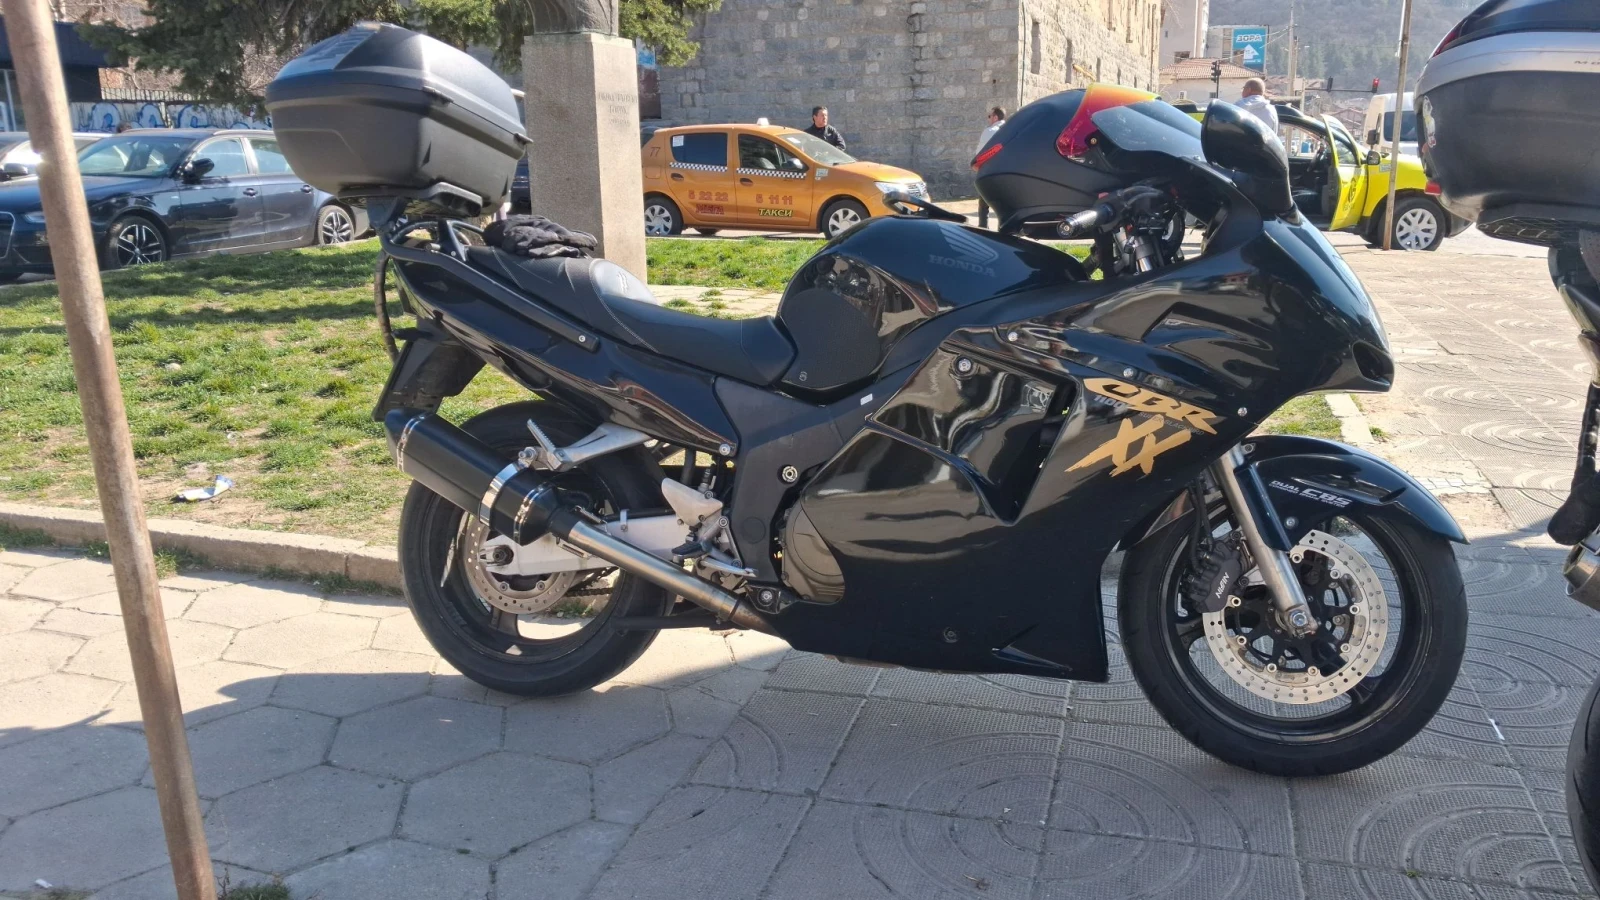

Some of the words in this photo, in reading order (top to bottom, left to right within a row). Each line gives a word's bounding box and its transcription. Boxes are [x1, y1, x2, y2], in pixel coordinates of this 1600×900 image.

[758, 208, 793, 217] ТАКСИ
[928, 253, 997, 278] HONDA
[1083, 377, 1218, 435] CBR
[1064, 413, 1192, 478] XX
[1271, 480, 1299, 492] DUAL
[1302, 488, 1353, 506] CBS
